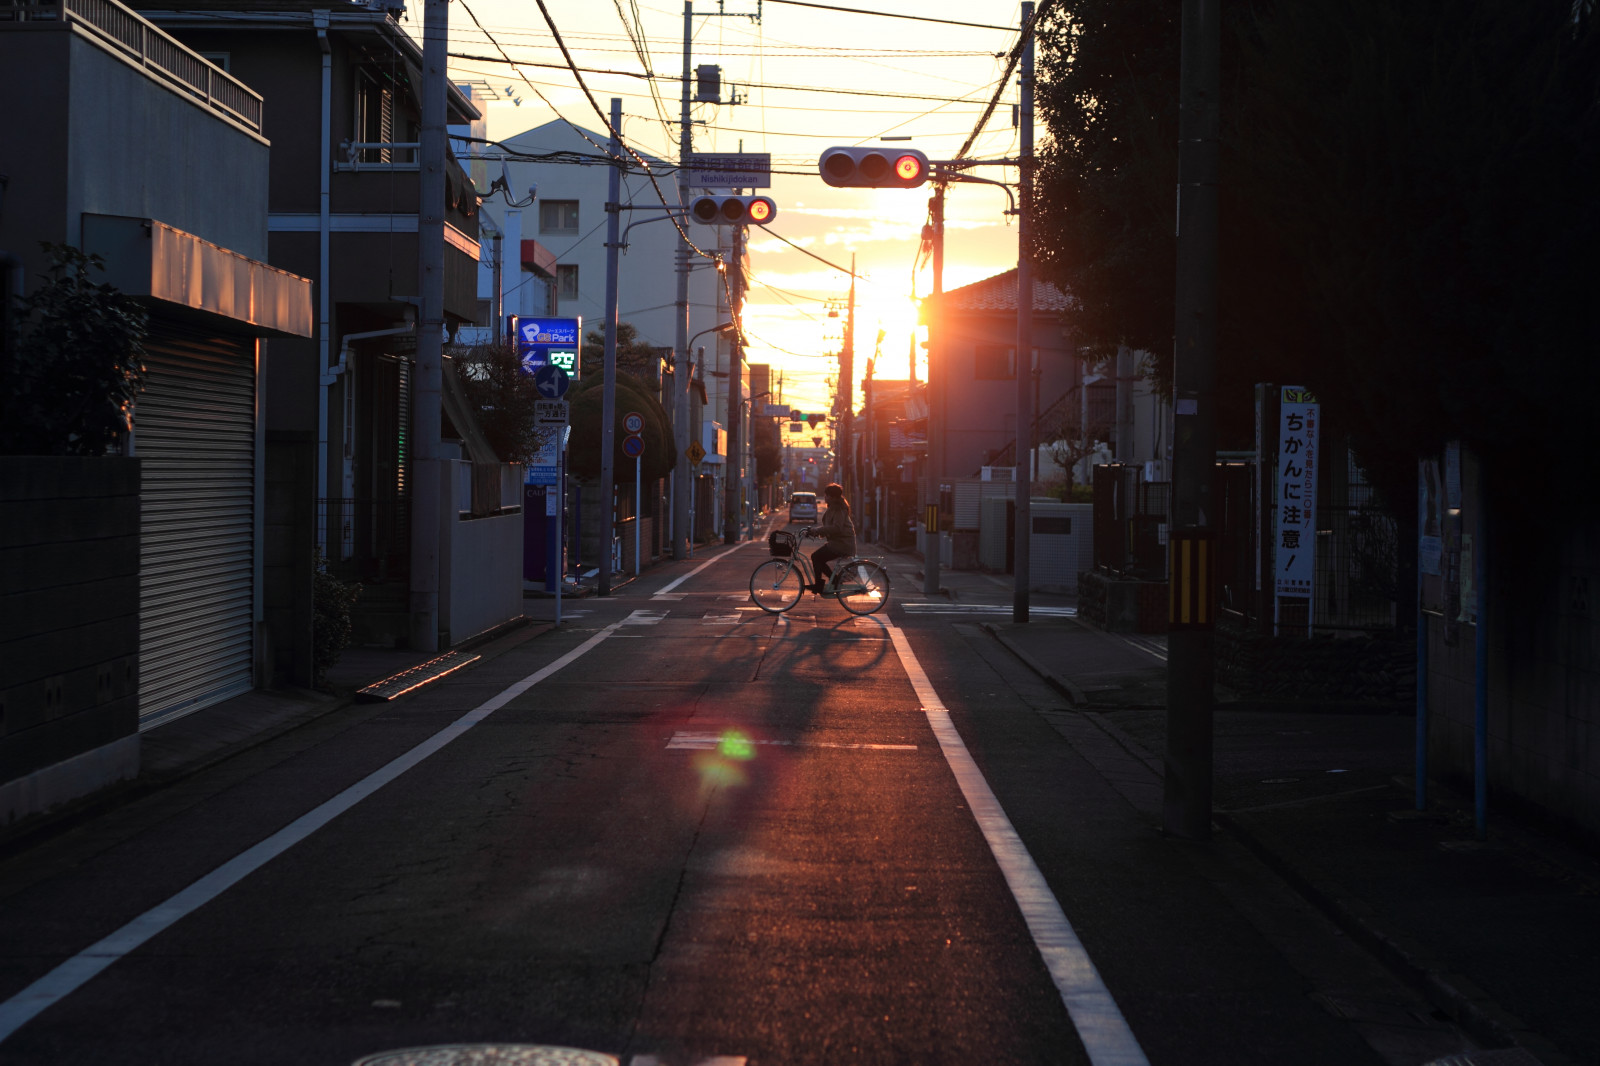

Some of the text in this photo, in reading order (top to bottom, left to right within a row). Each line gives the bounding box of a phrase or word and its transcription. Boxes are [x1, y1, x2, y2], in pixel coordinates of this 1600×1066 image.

[701, 175, 758, 184] Nishikijidokan
[552, 333, 574, 342] Park
[550, 352, 575, 377] 空
[536, 410, 566, 418] 一方通行
[628, 418, 641, 428] 30
